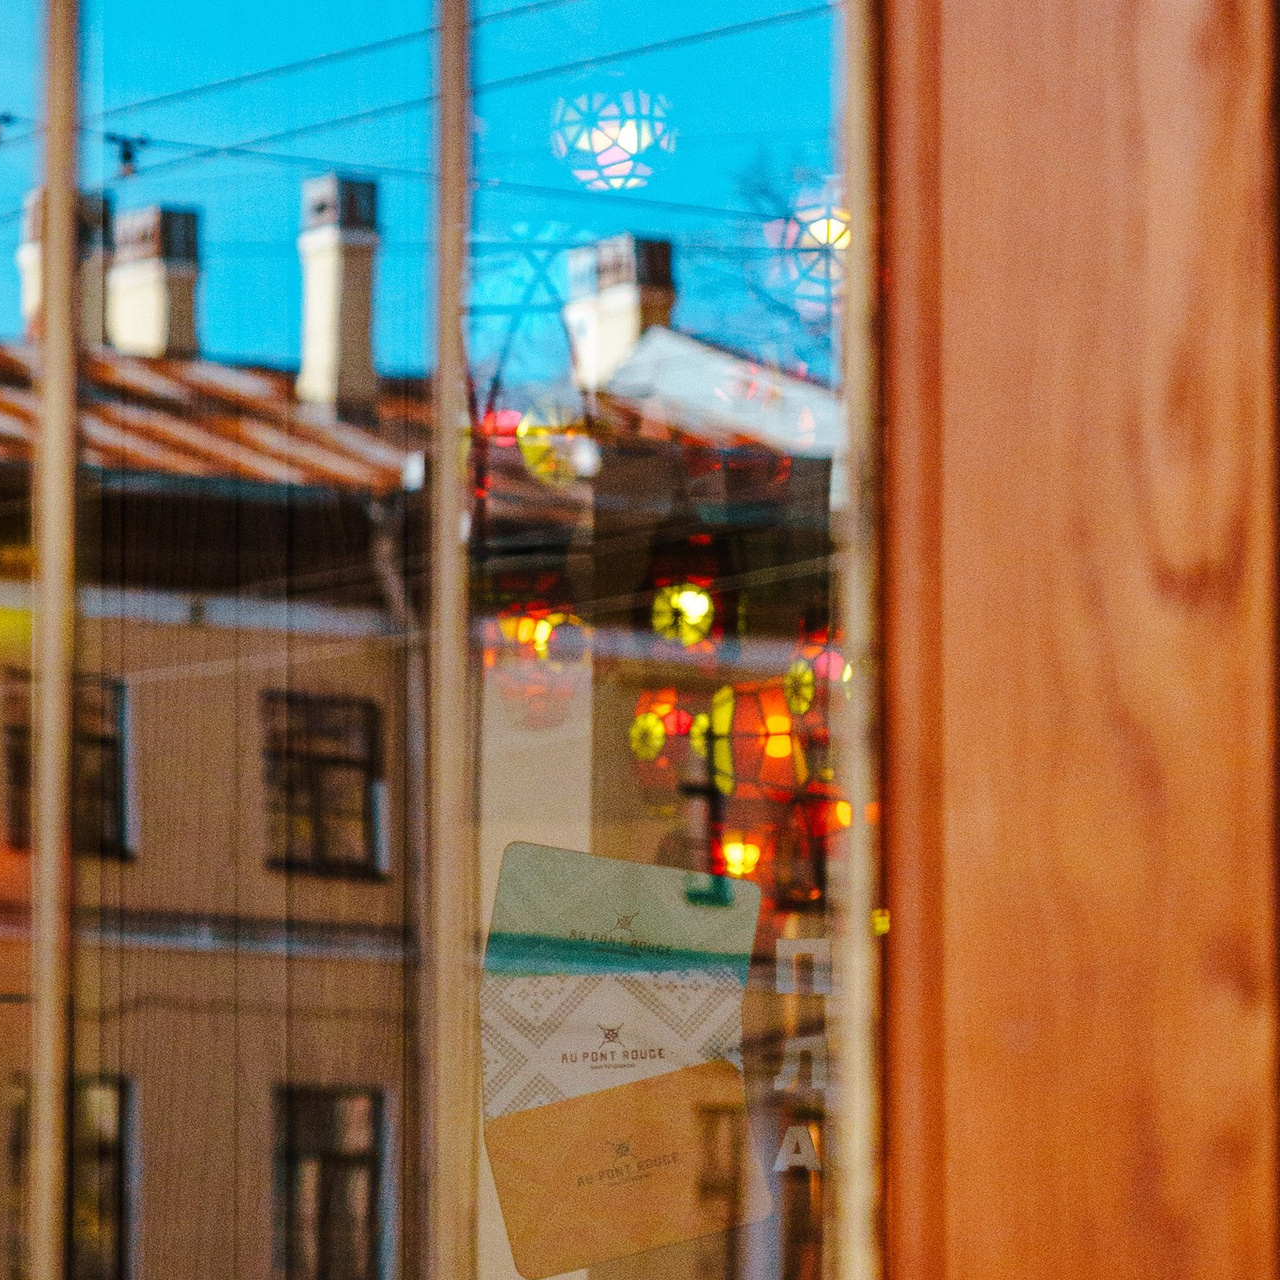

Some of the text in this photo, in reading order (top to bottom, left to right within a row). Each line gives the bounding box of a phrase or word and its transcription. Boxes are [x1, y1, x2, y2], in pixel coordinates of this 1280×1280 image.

[561, 1047, 665, 1063] AU PONT ROUGE
